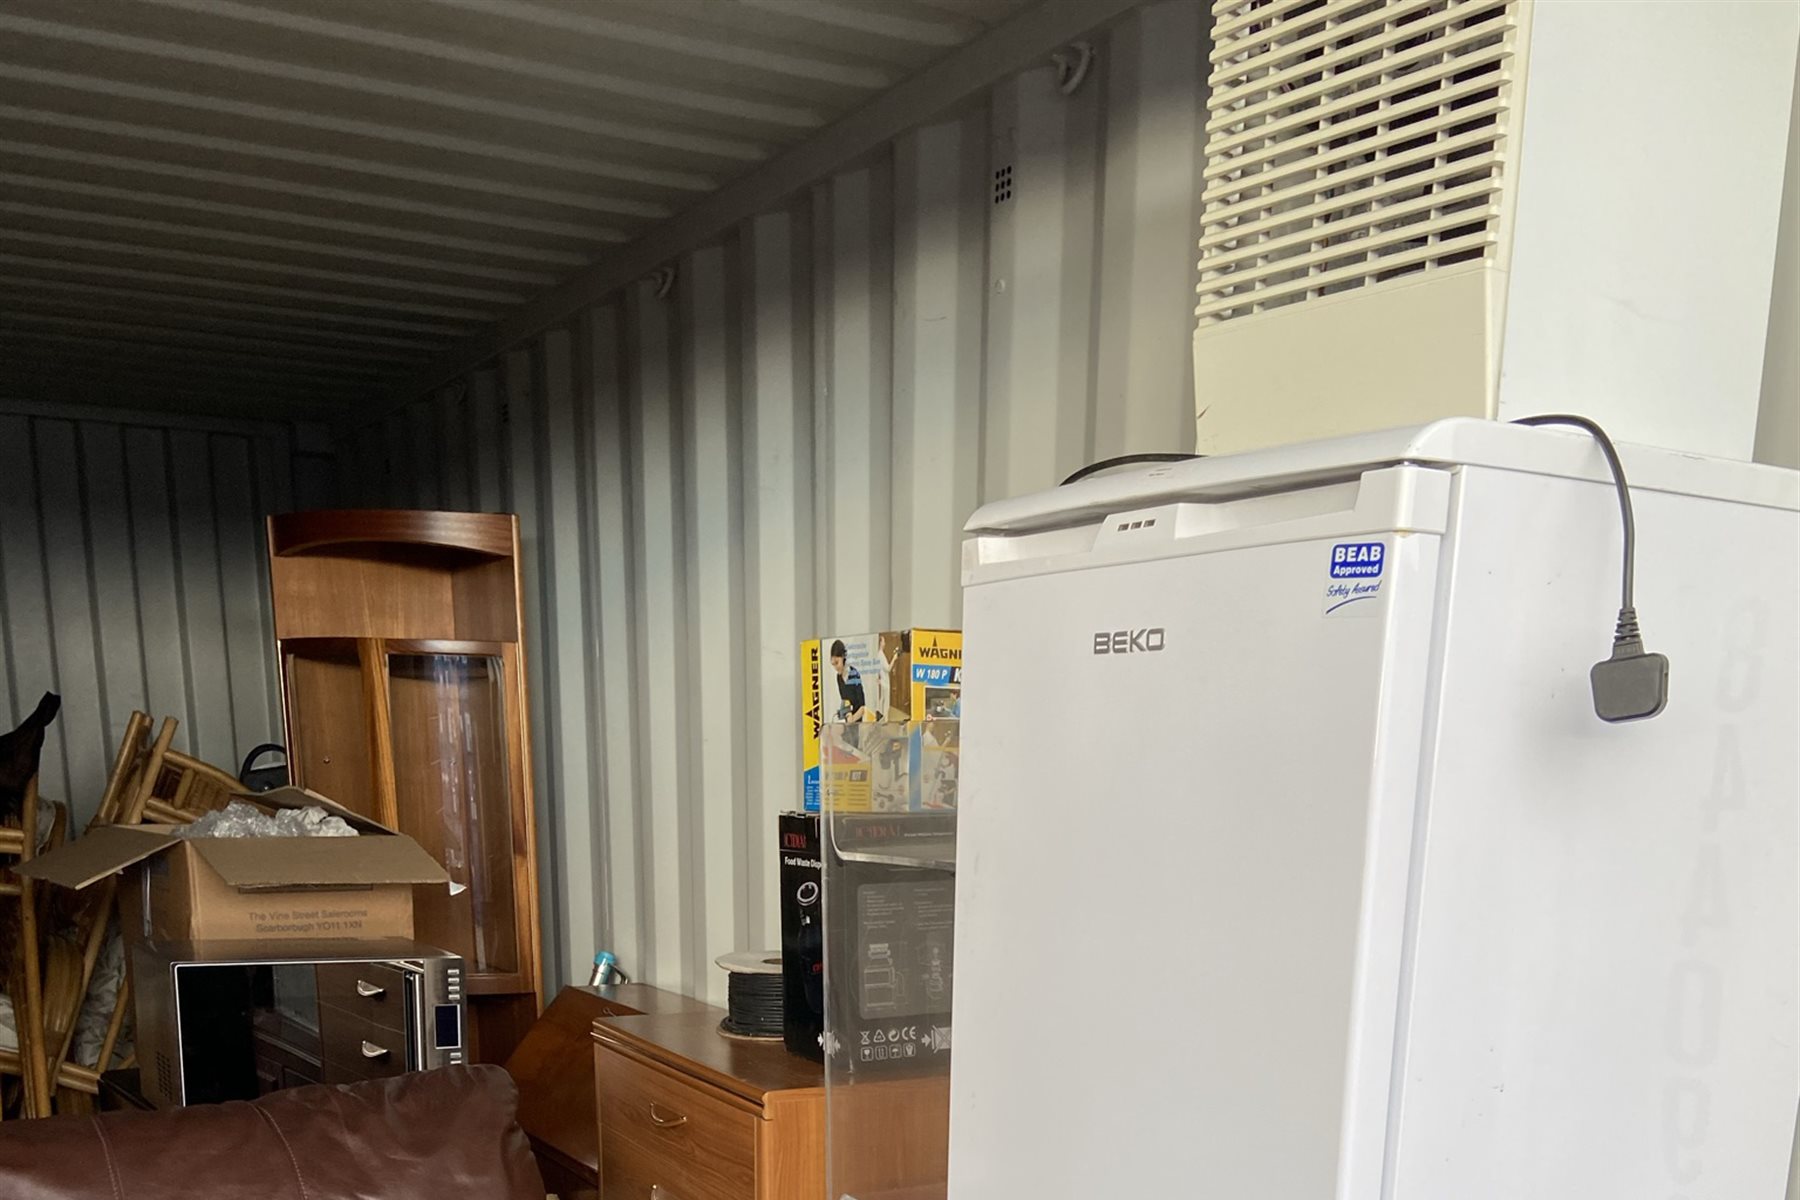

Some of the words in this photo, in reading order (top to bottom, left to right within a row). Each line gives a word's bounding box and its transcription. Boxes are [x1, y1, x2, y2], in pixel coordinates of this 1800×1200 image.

[1335, 546, 1382, 562] BEAB
[1333, 564, 1380, 577] Approved
[1325, 583, 1350, 598] Safety
[1351, 580, 1382, 594] Assured
[1093, 628, 1165, 654] BEKO
[915, 667, 924, 680] W
[926, 669, 939, 680] 180
[941, 671, 948, 680] P
[807, 647, 820, 740] WAGNER
[784, 855, 796, 866] Food
[796, 857, 810, 867] Waste
[249, 911, 267, 921] The
[269, 911, 290, 920] Vine
[292, 911, 319, 920] Street
[321, 909, 368, 919] Salerooms
[256, 922, 315, 933] Scarborough
[317, 921, 341, 930] YO11
